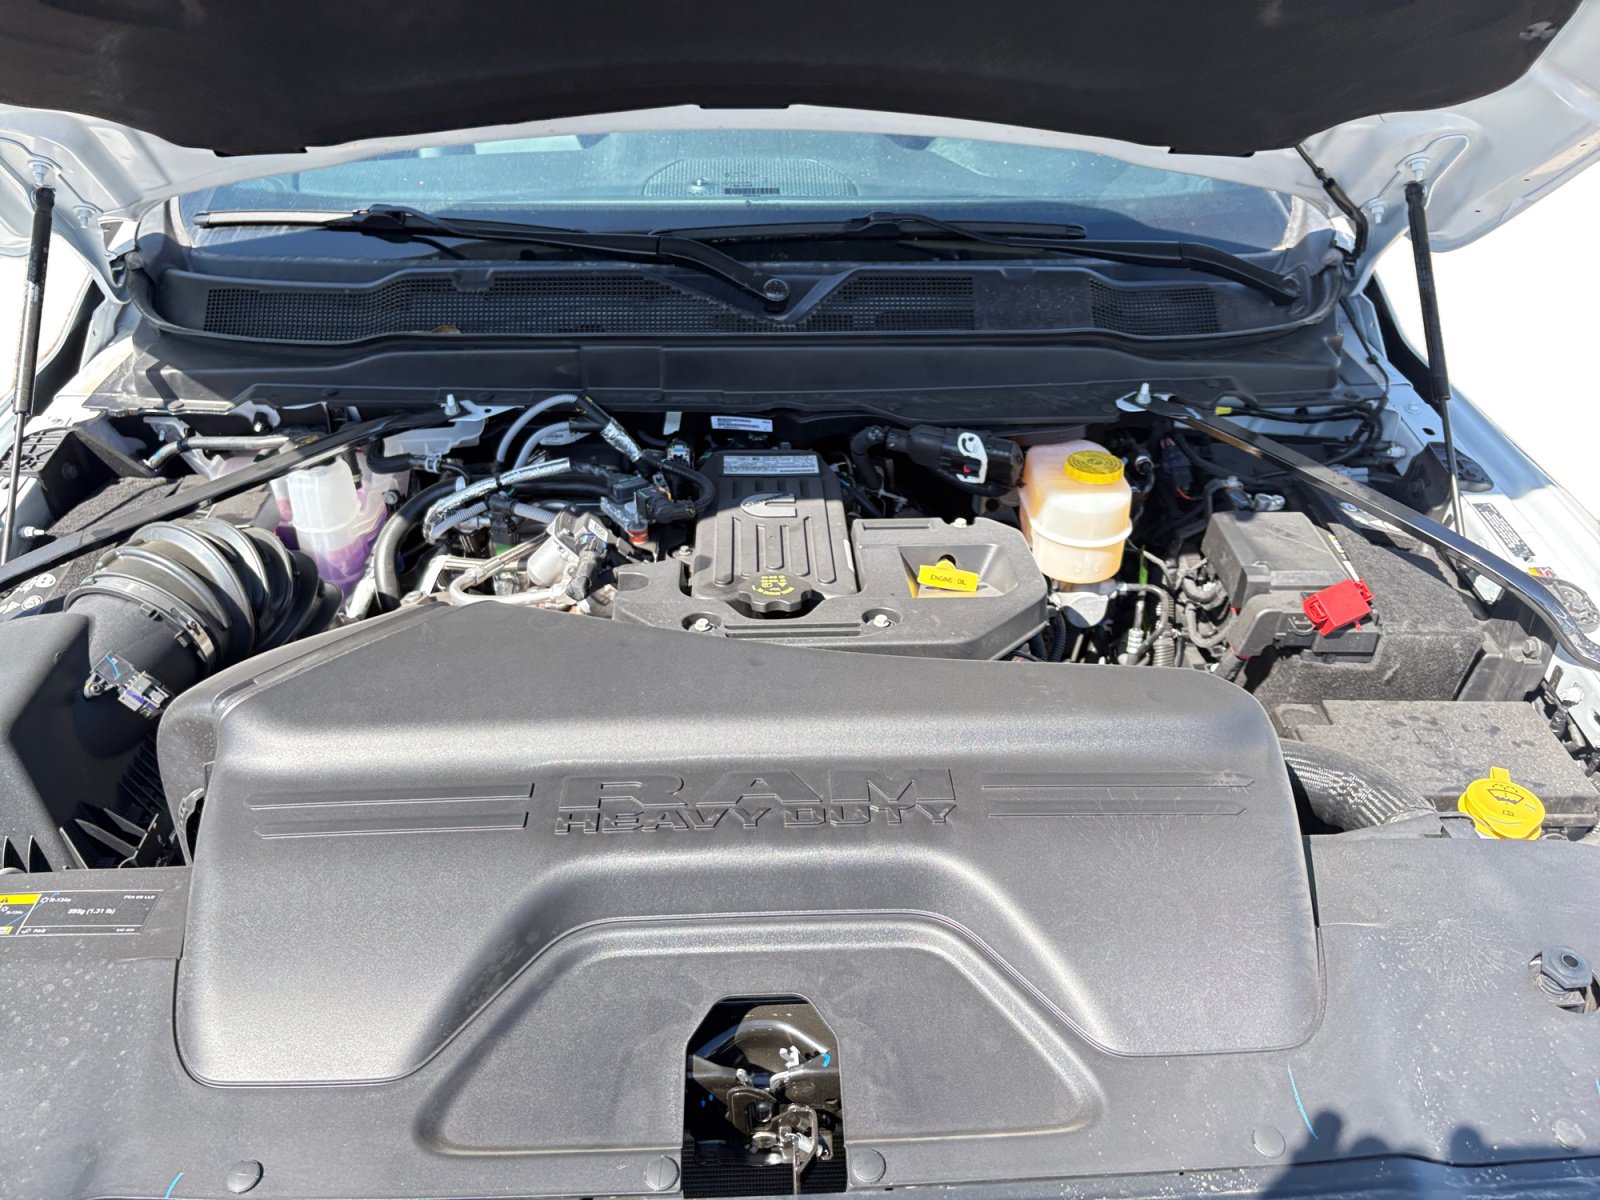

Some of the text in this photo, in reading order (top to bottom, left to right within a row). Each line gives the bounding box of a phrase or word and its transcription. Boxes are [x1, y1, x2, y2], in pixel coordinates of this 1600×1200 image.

[930, 574, 967, 586] ENGINE OIL
[558, 767, 956, 811] RAM
[554, 804, 958, 835] HEAVY DUTY
